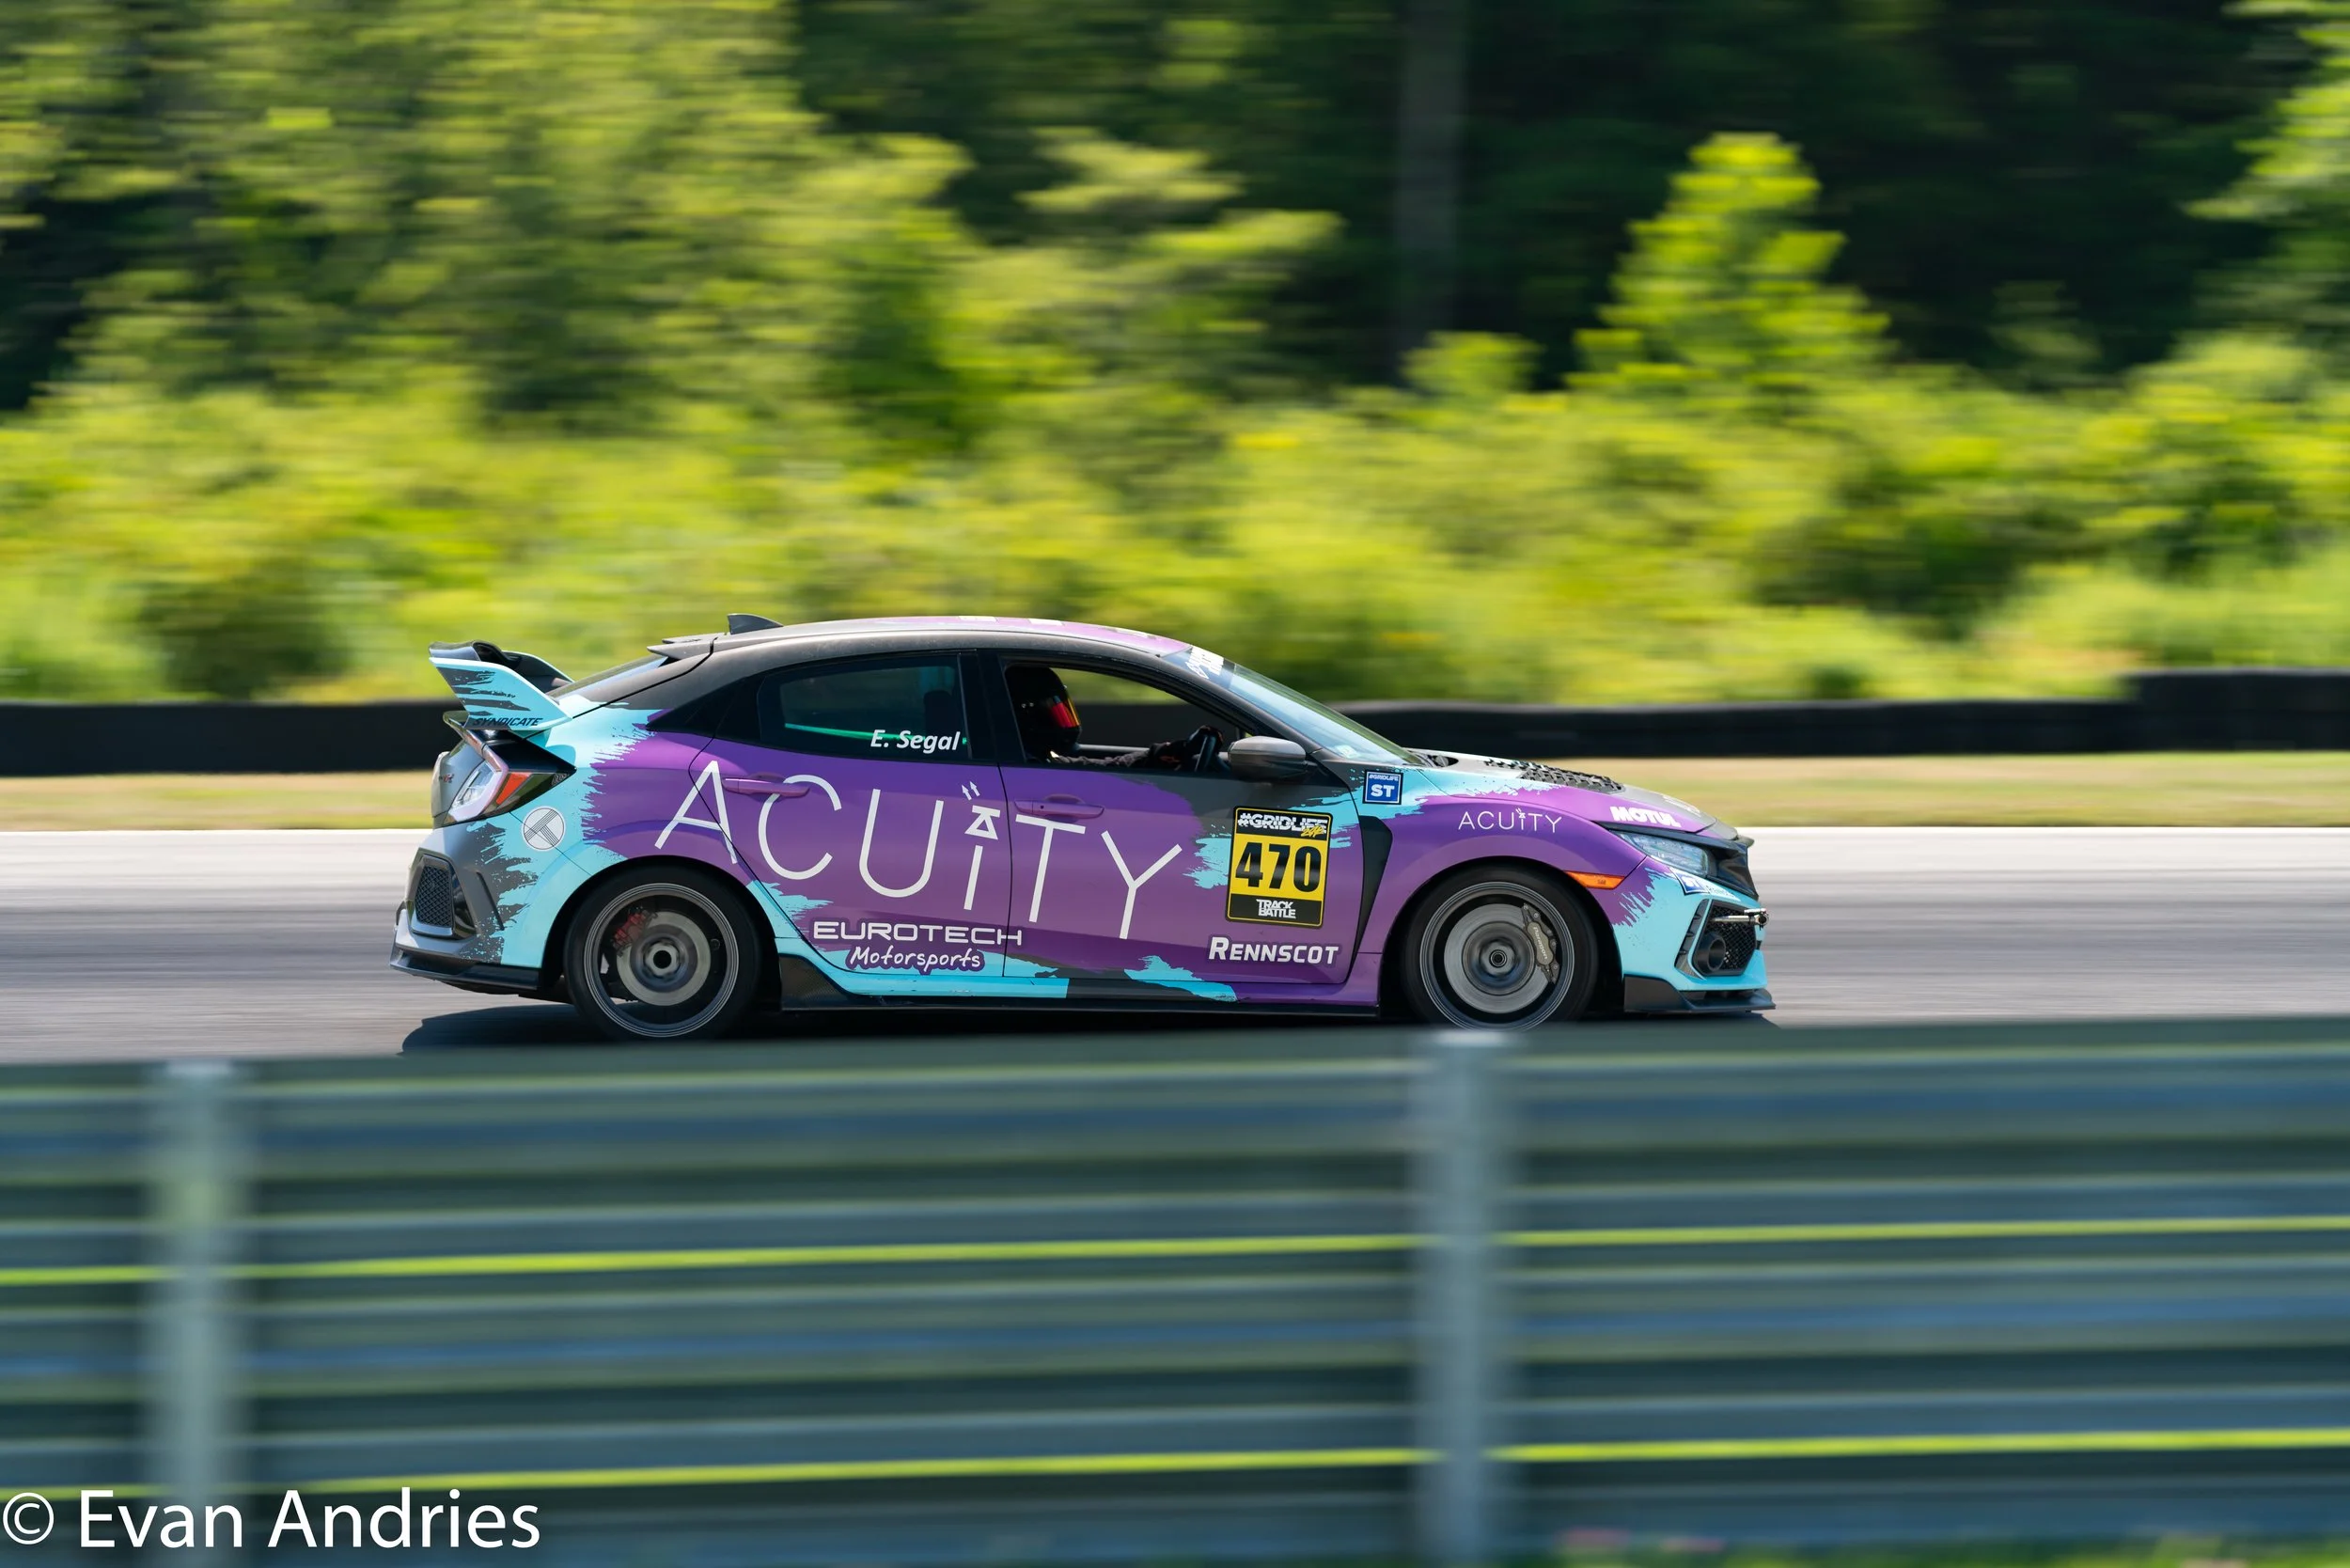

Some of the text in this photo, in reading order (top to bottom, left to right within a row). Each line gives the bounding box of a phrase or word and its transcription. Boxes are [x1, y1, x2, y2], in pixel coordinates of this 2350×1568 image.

[473, 717, 543, 727] SYNDICATE
[870, 729, 961, 754] E. Segal
[1371, 784, 1395, 797] ST
[1609, 806, 1682, 827] MOTUL
[1235, 841, 1322, 892] 470
[1256, 899, 1293, 909] TRACK
[1258, 907, 1296, 918] BATTLE
[813, 920, 1023, 946] EUROTECH
[849, 945, 981, 972] Motorsports
[1208, 936, 1340, 964] RENNSCOT
